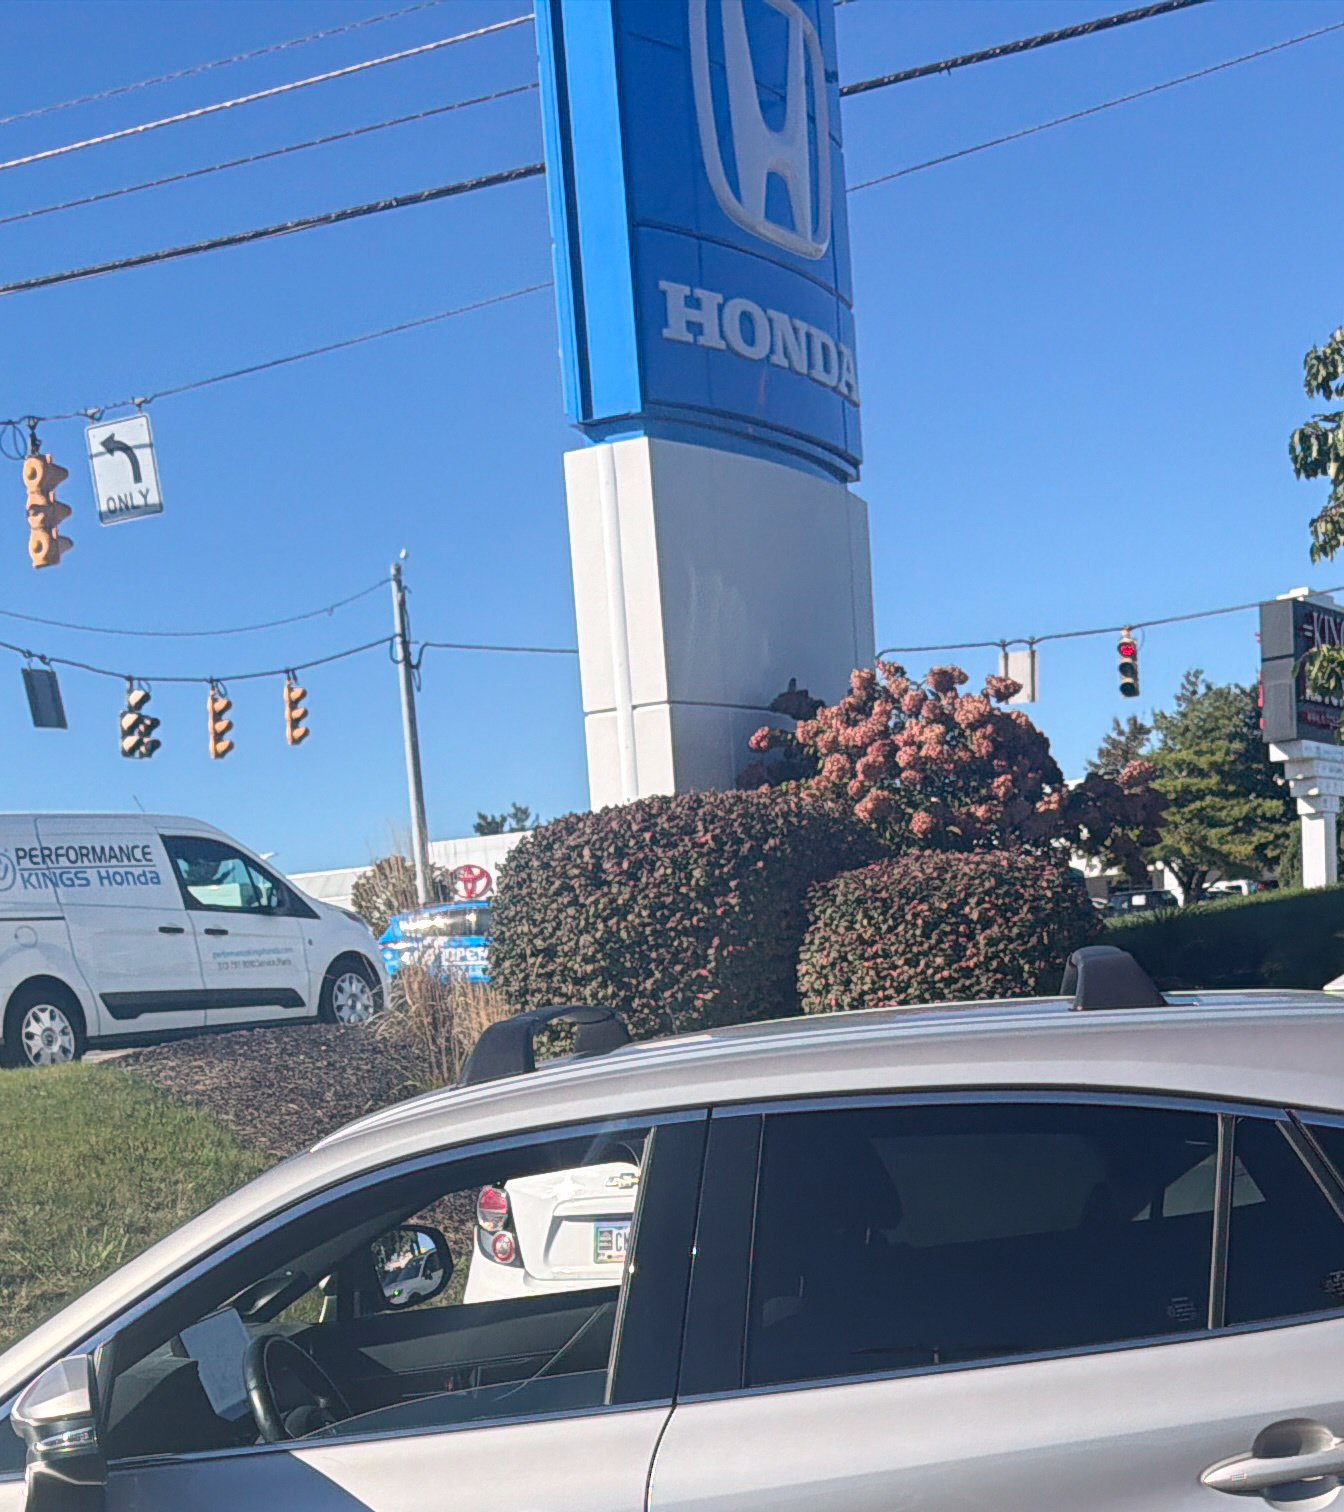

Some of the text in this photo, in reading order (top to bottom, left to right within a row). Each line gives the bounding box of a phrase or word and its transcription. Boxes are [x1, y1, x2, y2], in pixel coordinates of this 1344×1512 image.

[659, 280, 860, 408] HONDA
[106, 488, 150, 514] ONLY
[15, 844, 154, 866] PERFORMANCE
[21, 868, 161, 890] KINGS Honda
